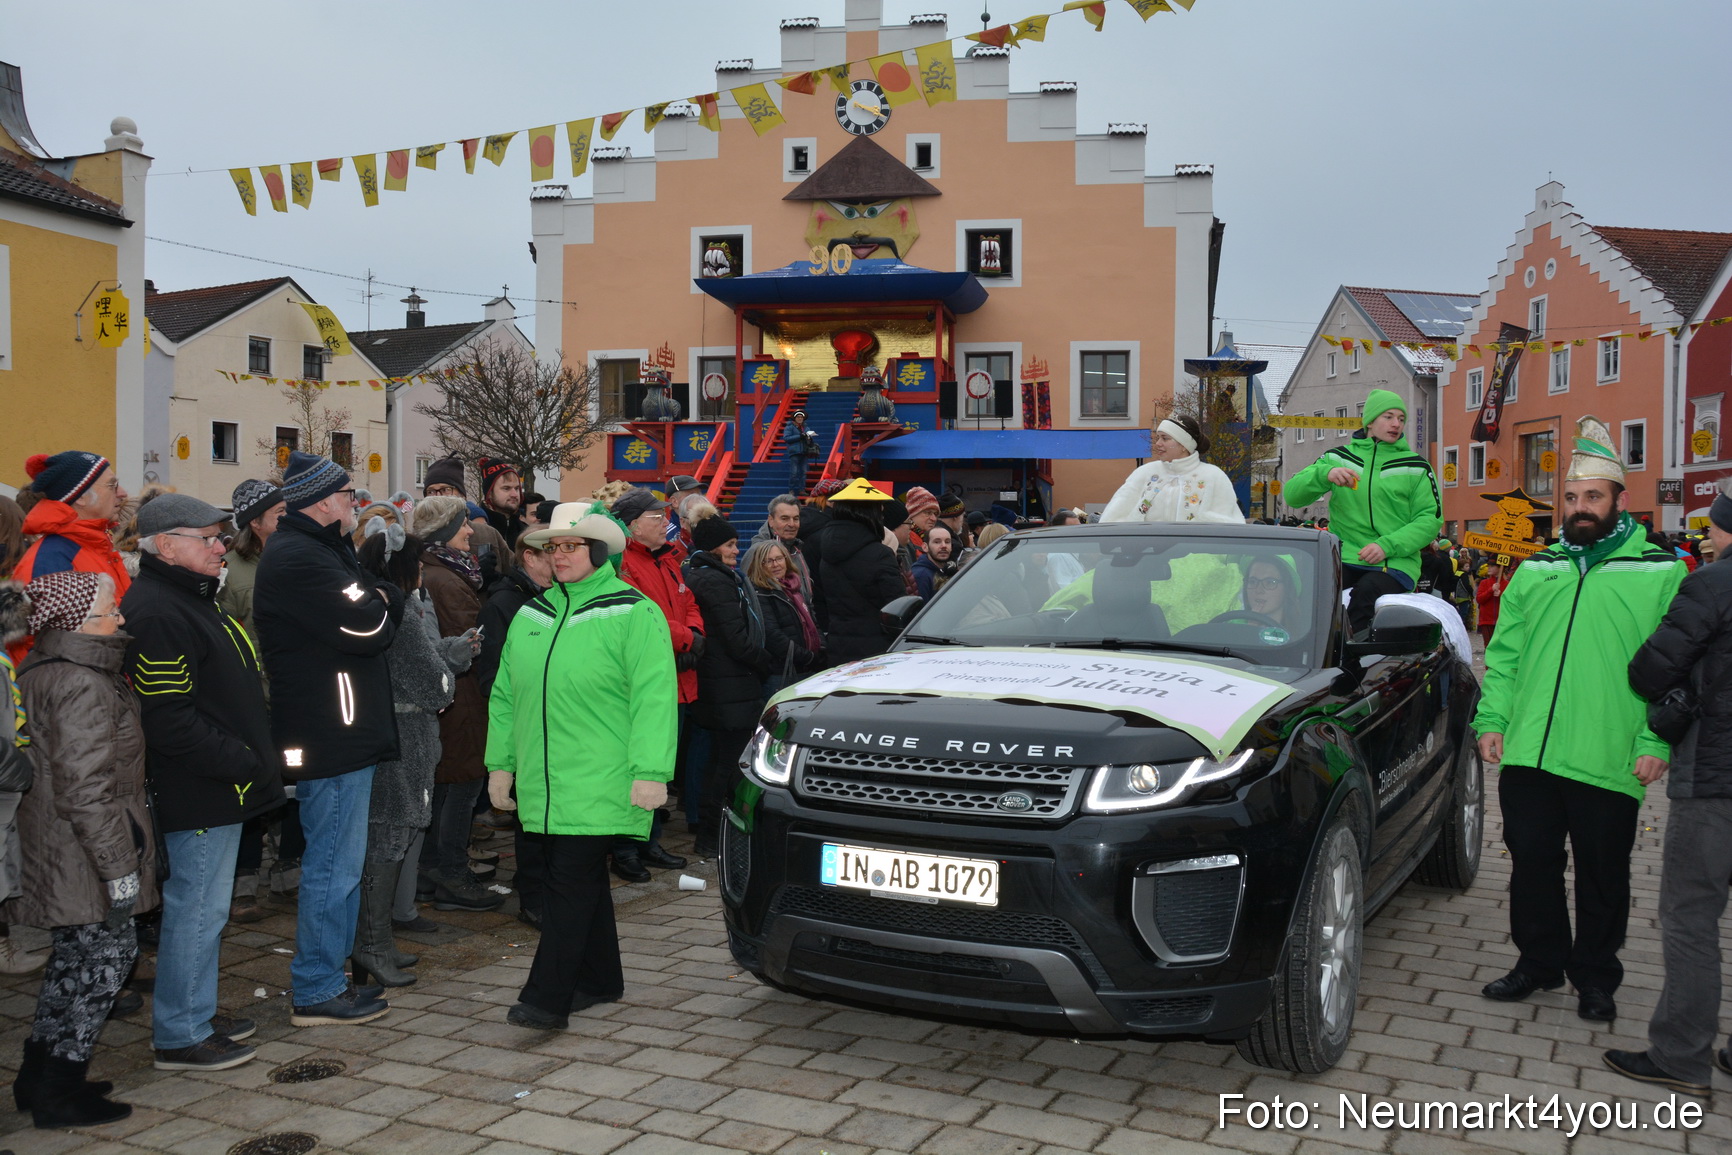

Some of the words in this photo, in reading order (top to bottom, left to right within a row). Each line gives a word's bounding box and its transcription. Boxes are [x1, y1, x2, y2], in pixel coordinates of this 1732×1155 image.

[809, 244, 852, 275] 90
[1660, 481, 1680, 492] CAFÉ
[1472, 537, 1502, 551] Yin-Yang
[1508, 543, 1539, 556] Chinesi
[1497, 556, 1509, 565] 40
[1543, 574, 1558, 582] JAKO
[1081, 662, 1204, 686] Svenja
[1045, 675, 1170, 698] Julian
[809, 727, 920, 749] RANGE
[945, 739, 1074, 758] ROVER
[840, 852, 869, 884] IN
[889, 858, 920, 889] AB
[927, 862, 993, 898] 1079
